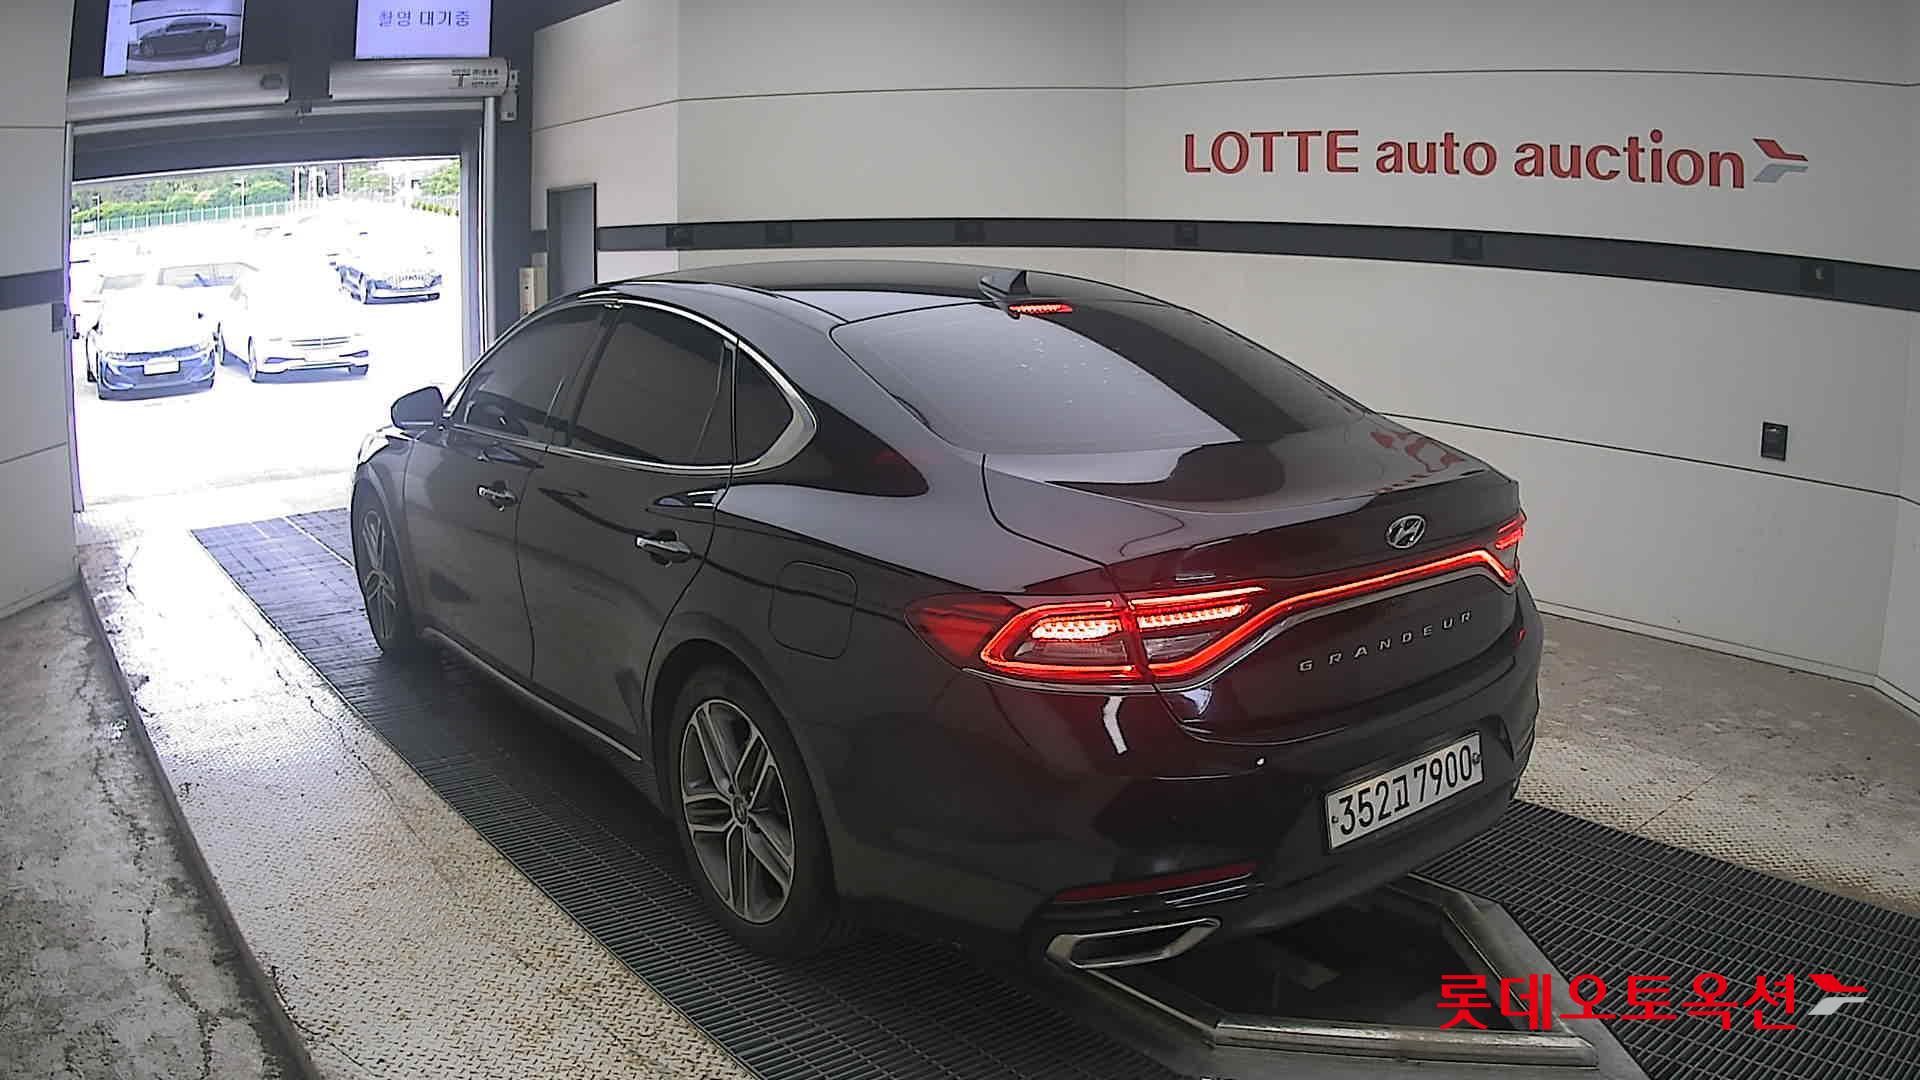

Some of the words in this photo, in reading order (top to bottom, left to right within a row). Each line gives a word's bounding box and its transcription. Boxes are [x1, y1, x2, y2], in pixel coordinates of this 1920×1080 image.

[419, 9, 473, 28] 대기중
[1184, 129, 1360, 174] LOTTE
[1375, 131, 1498, 176] auto
[1514, 129, 1746, 189] auction
[1299, 610, 1473, 672] GRANDEUR
